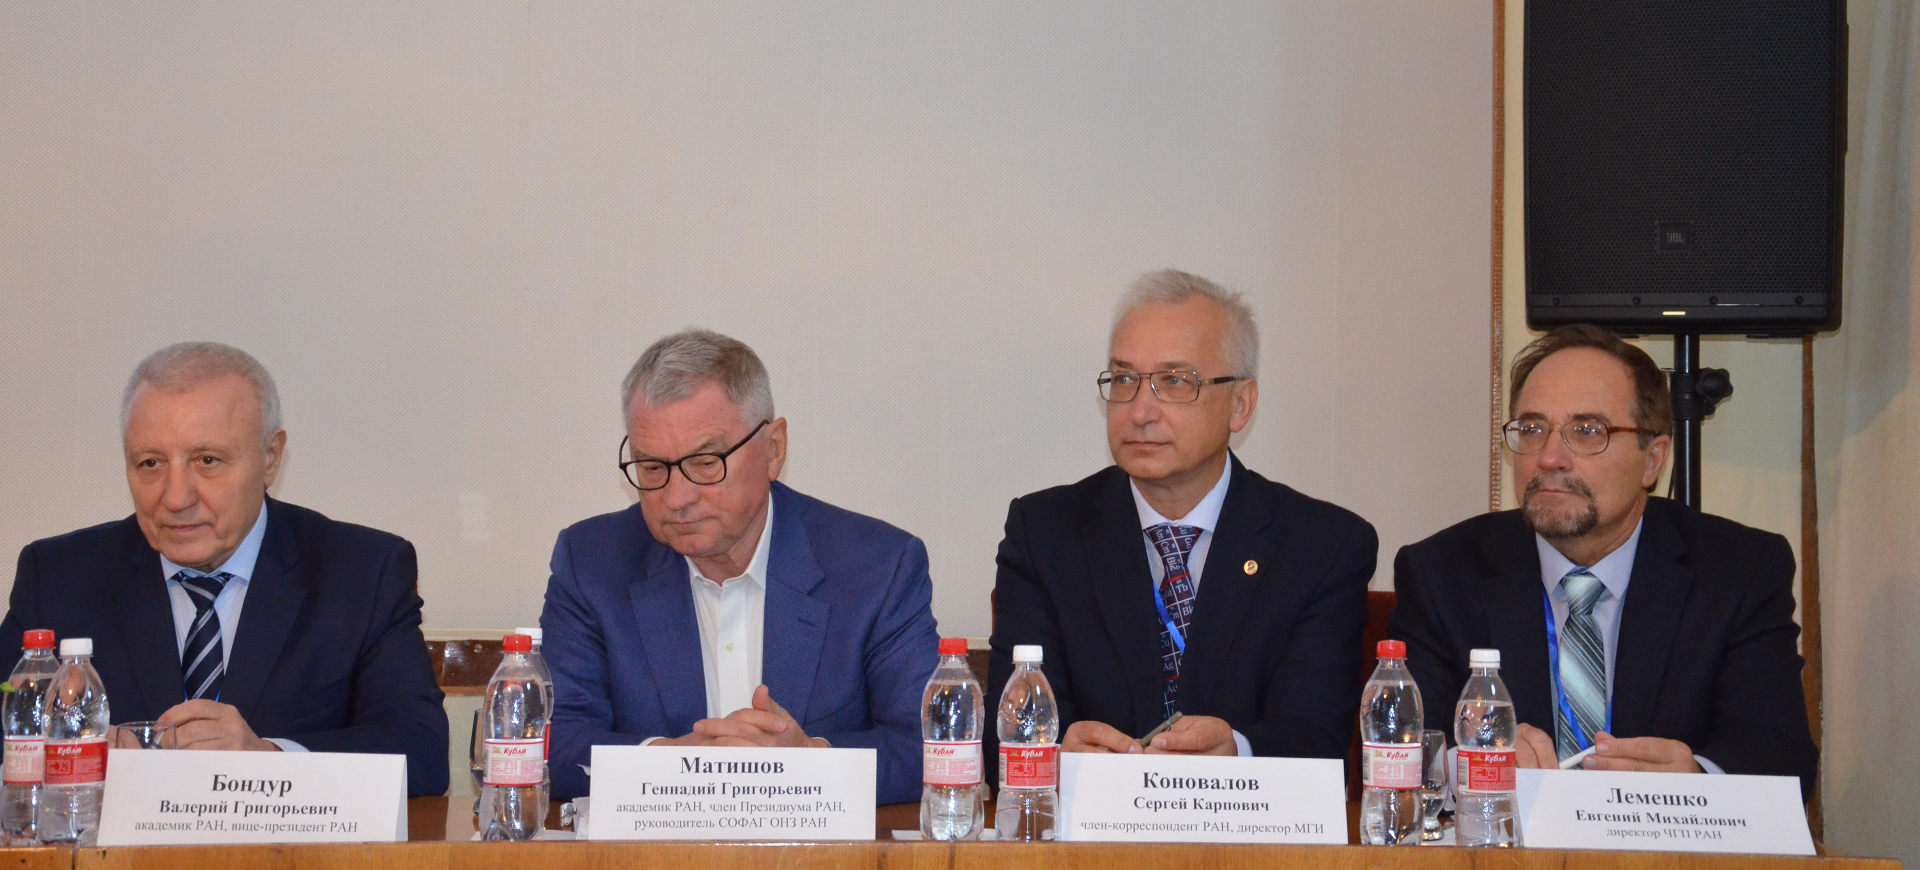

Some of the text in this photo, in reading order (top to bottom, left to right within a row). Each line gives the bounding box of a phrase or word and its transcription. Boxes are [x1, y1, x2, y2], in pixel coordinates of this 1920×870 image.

[1666, 231, 1685, 244] JBL
[1175, 583, 1189, 593] Tb
[679, 754, 785, 777] Матишов
[210, 772, 294, 798] Бондур
[641, 780, 823, 798] Геннадий Григорьевич
[1142, 770, 1261, 793] Коновалов
[1133, 795, 1271, 814] Сергей Карпович
[1605, 786, 1708, 808] Лемешко
[159, 799, 339, 818] Валерий Григорьевич
[615, 800, 847, 816] академик РАН, член Президиума РАН,
[134, 818, 359, 835] академик РАН, вице-президент РАН
[633, 816, 828, 832] руководитель СОФАГ ОНЗ РАН
[1575, 807, 1748, 828] Евгений Михайлович
[1080, 820, 1325, 836] член-корреспондент РАН, директор МГИ
[1605, 827, 1723, 840] директор ЧГП РАН
